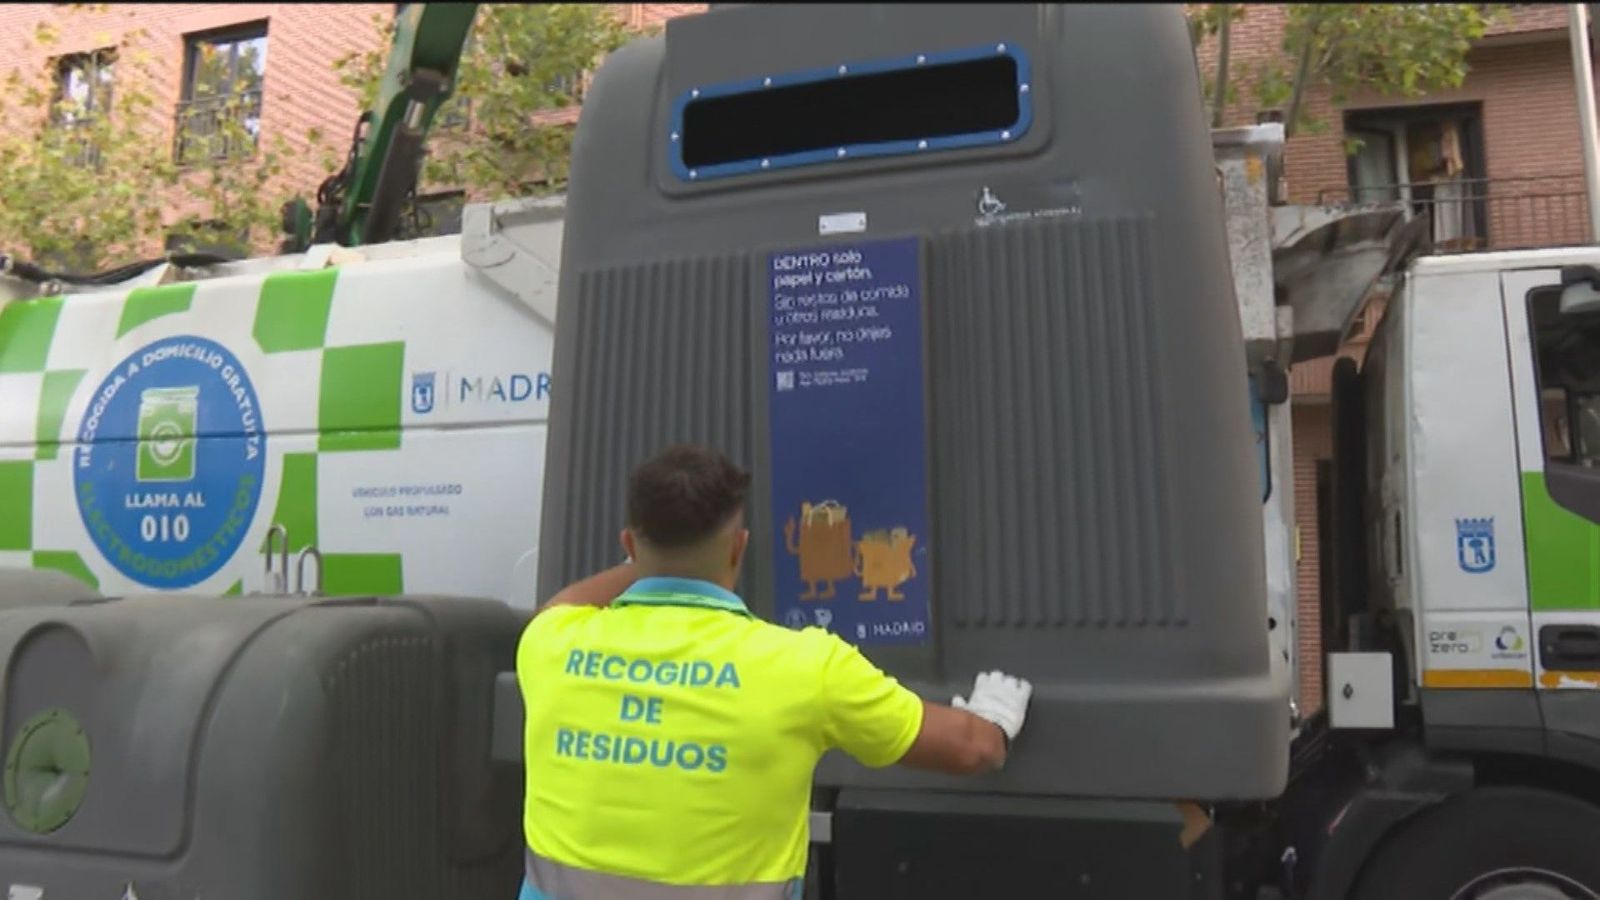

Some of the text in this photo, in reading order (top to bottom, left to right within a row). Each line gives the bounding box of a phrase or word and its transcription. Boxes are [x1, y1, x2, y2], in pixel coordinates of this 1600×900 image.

[774, 250, 862, 270] DENTRO solo
[774, 271, 813, 289] papel
[815, 272, 823, 286] y
[774, 284, 910, 310] Sin restos de comida
[774, 332, 798, 346] Por
[836, 331, 854, 342] no
[775, 348, 809, 364] nada
[79, 342, 261, 468] RECOGIDA A DOMICILIO GRATUITA
[125, 491, 206, 509] LLAMA AL
[140, 514, 190, 543] 010
[873, 620, 925, 637] MADRID
[1431, 643, 1469, 654] zero
[565, 649, 741, 689] RECOGIDA
[620, 694, 664, 724] DE
[556, 727, 728, 774] RESIDUOS
